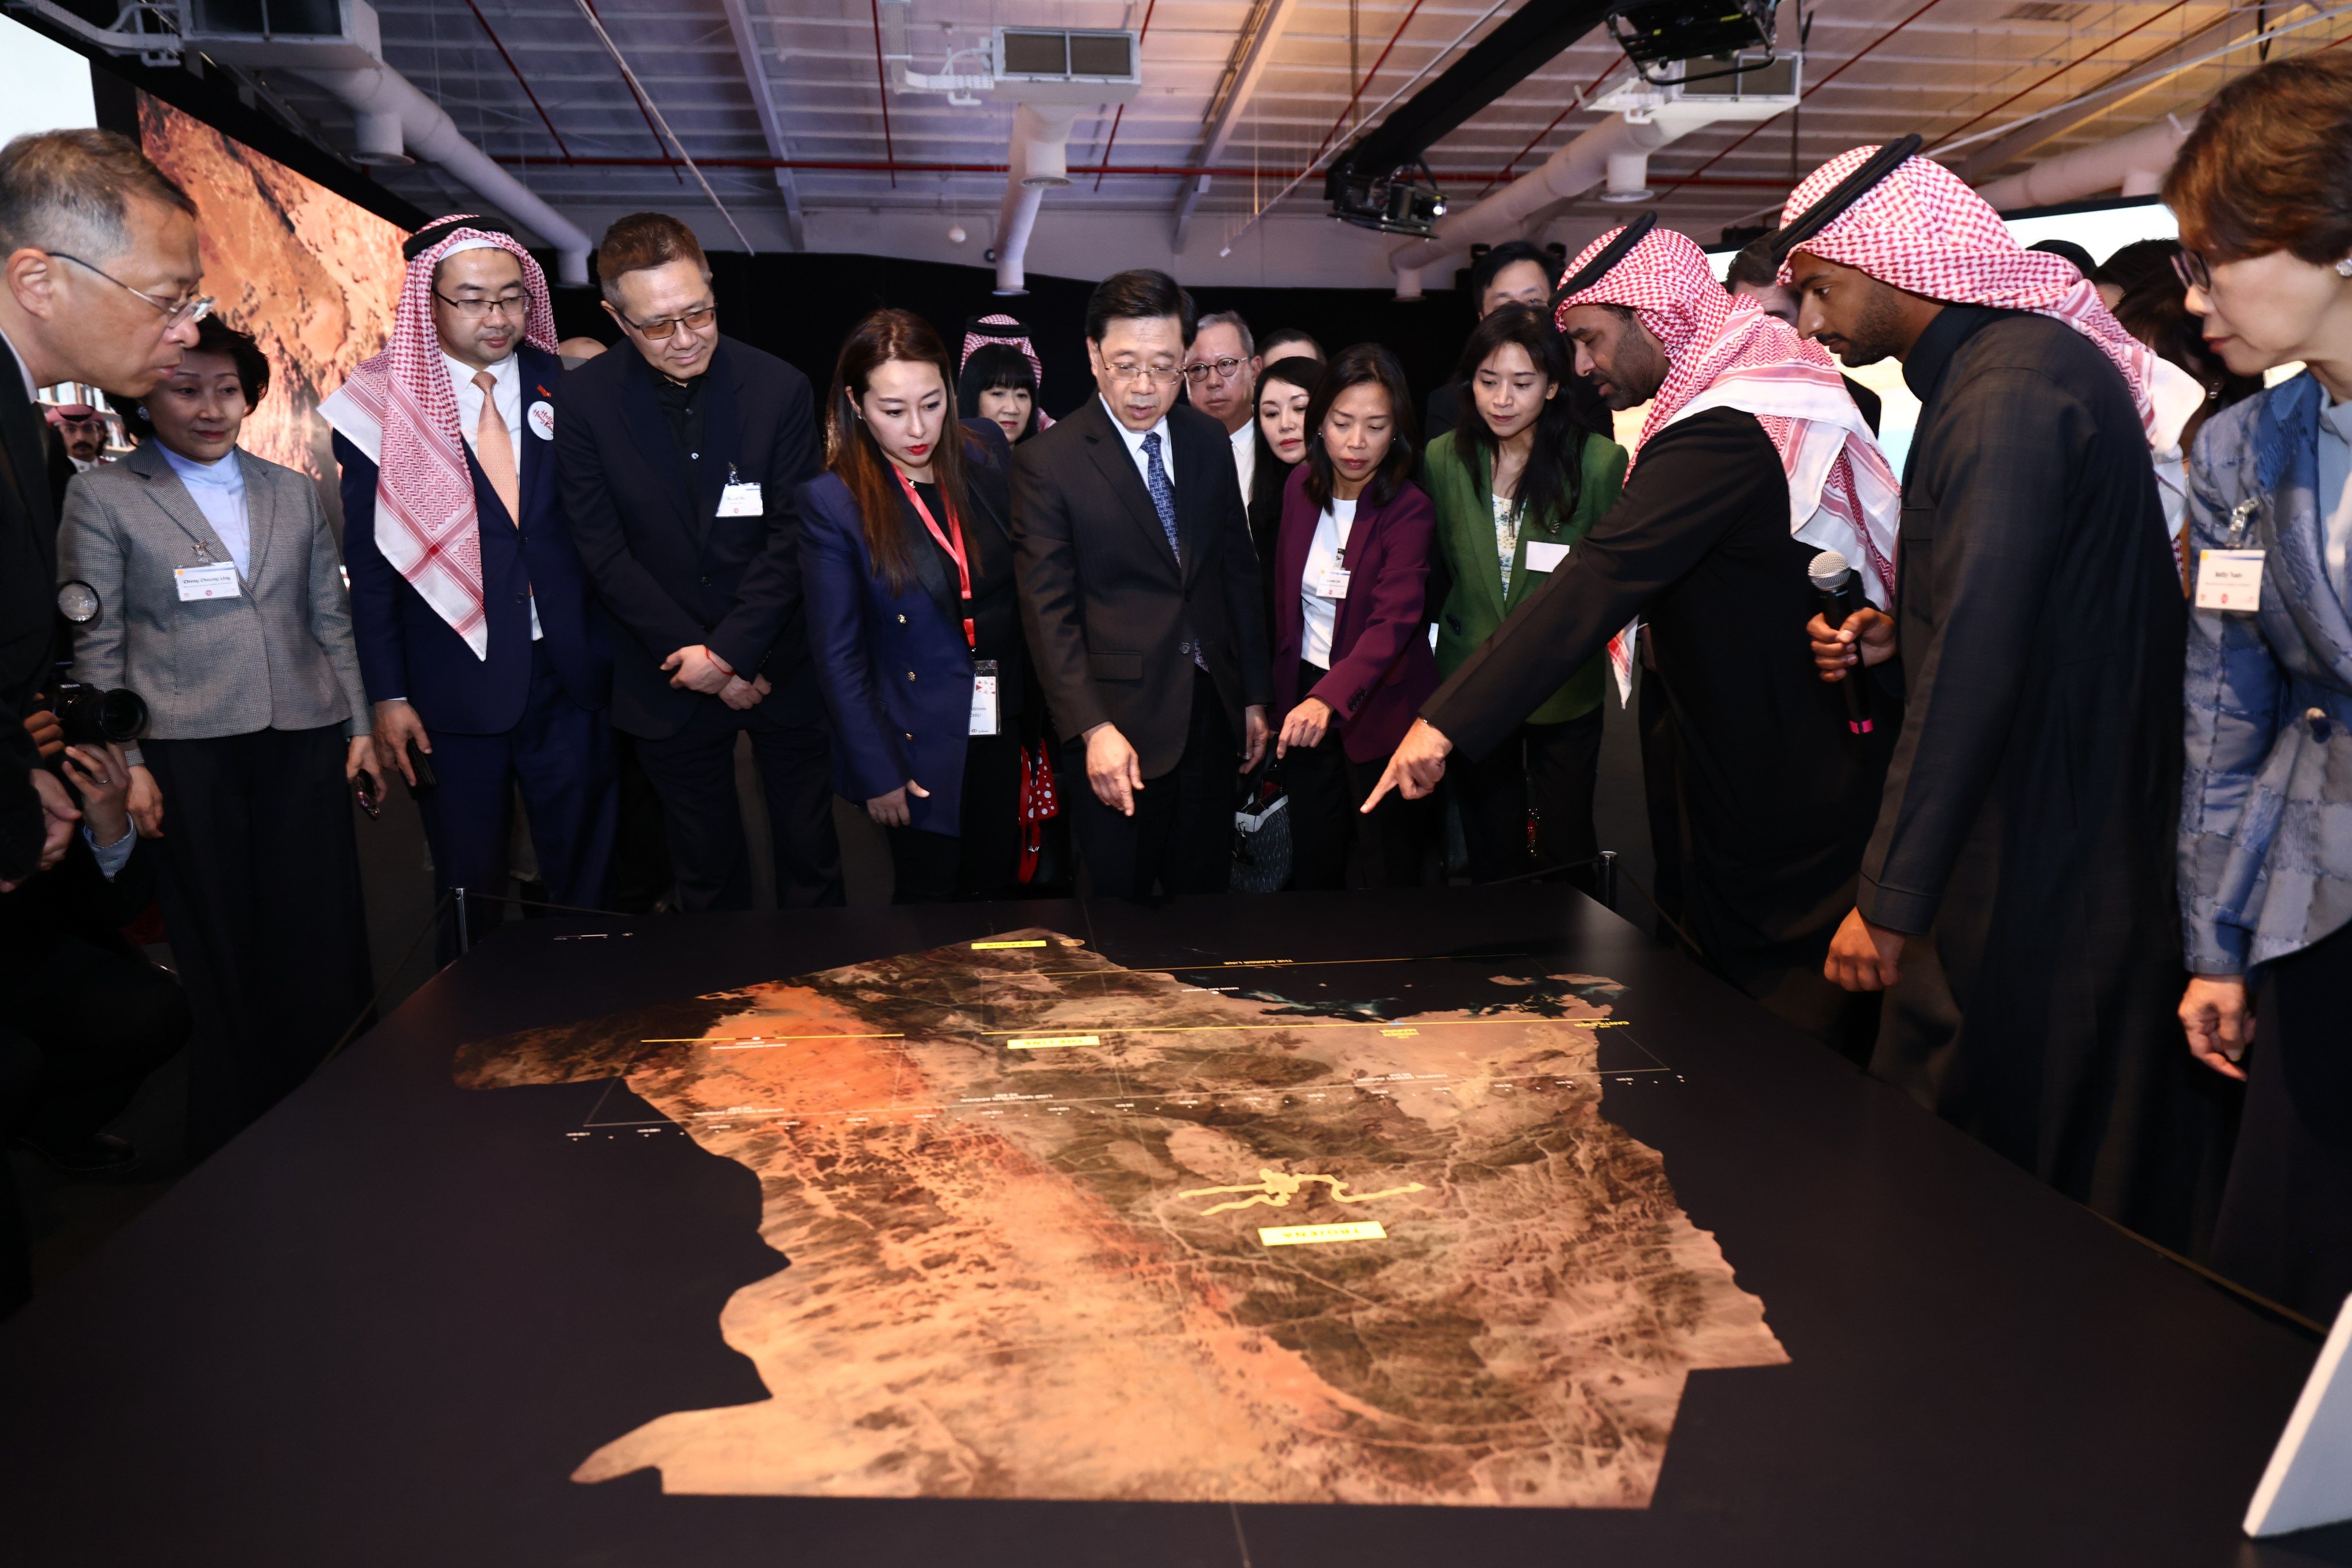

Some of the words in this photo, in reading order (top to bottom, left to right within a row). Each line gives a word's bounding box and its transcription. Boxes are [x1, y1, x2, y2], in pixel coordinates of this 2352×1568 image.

[532, 408, 545, 424] Hong
[540, 410, 554, 424] Hello
[1282, 1227, 1360, 1238] TROJENA
